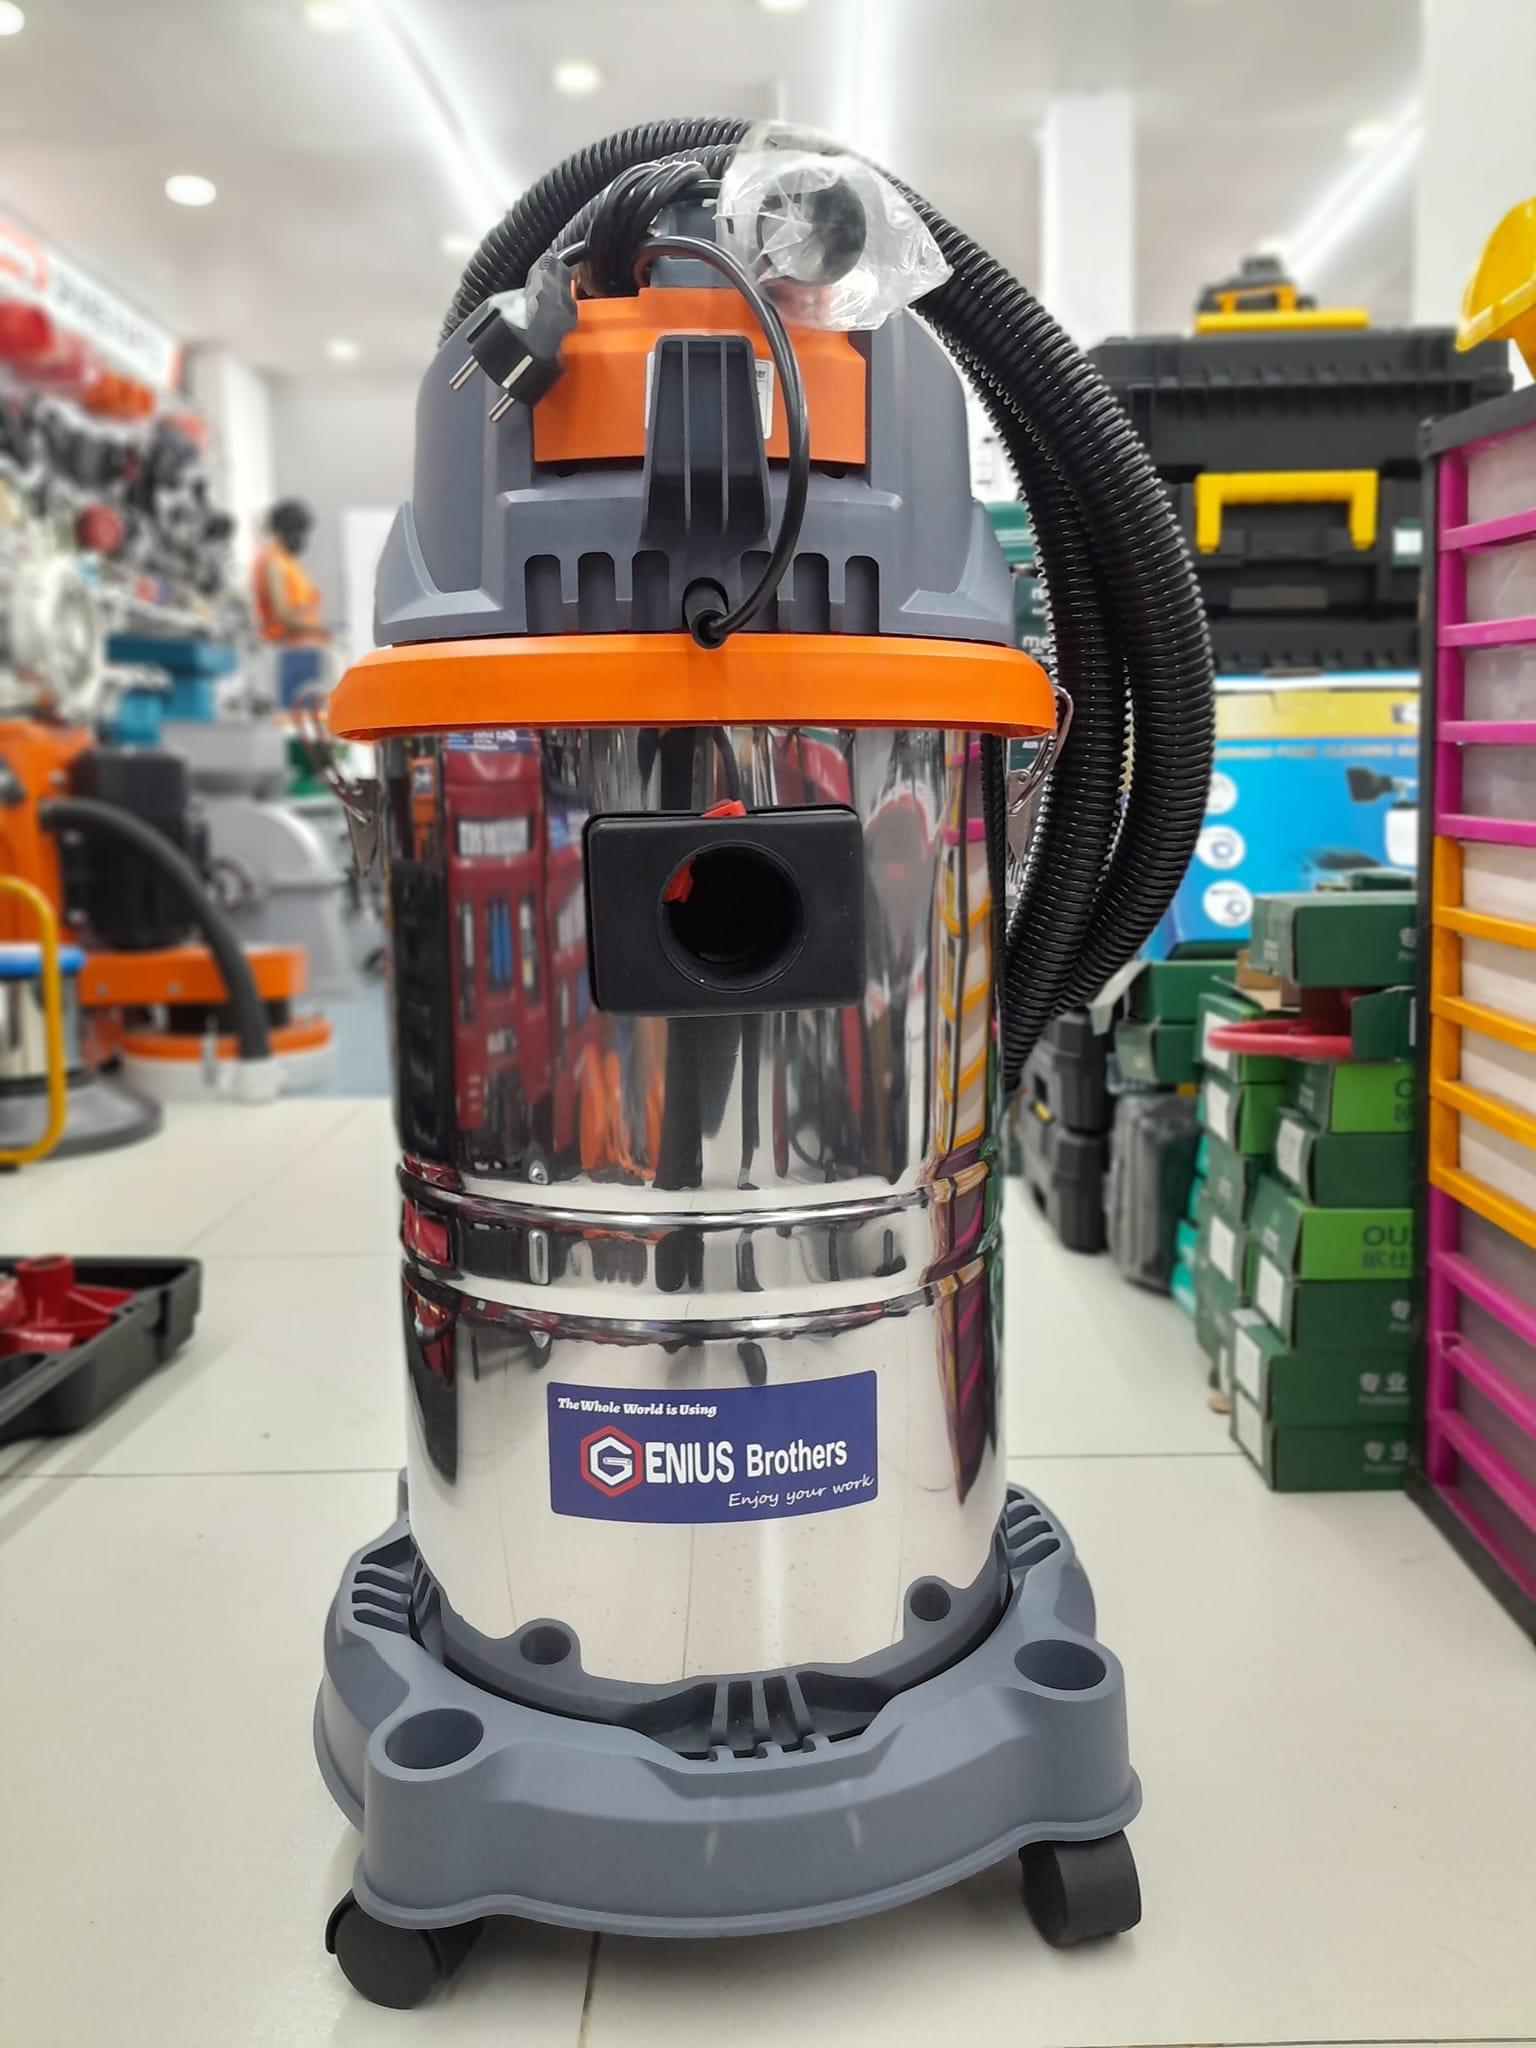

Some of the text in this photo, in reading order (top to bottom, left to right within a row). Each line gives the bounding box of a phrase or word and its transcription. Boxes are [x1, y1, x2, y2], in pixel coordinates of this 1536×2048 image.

[557, 1397, 718, 1418] The Whole World is Using
[746, 1438, 848, 1478] Brothers
[727, 1473, 875, 1509] Enjoy your work
